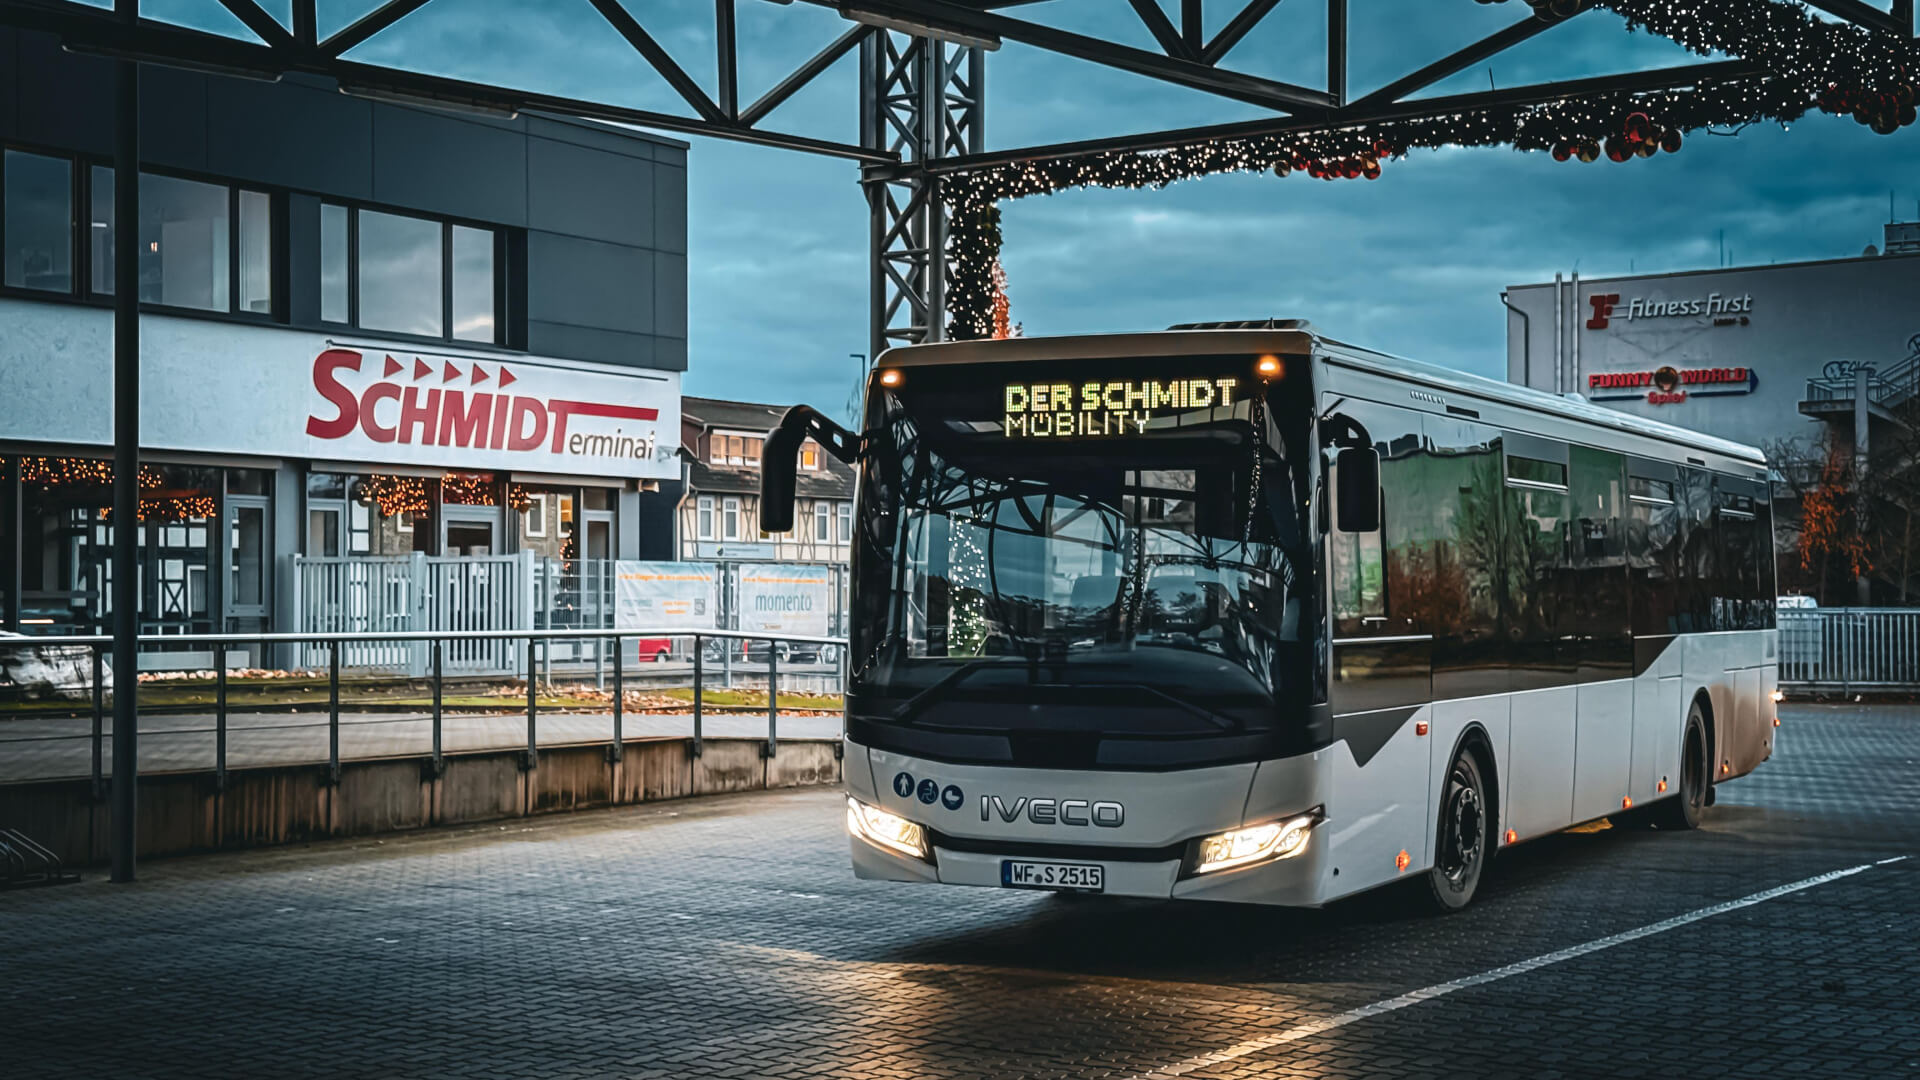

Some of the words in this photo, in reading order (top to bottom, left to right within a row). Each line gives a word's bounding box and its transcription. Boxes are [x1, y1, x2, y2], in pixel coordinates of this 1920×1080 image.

[1589, 373, 1653, 388] FUNNY
[1681, 367, 1747, 384] WORLD
[1006, 385, 1072, 412] DER
[1082, 379, 1236, 410] SCHMIDT
[755, 593, 813, 612] momento
[980, 795, 1125, 827] IVECO
[1058, 867, 1100, 886] 2515
